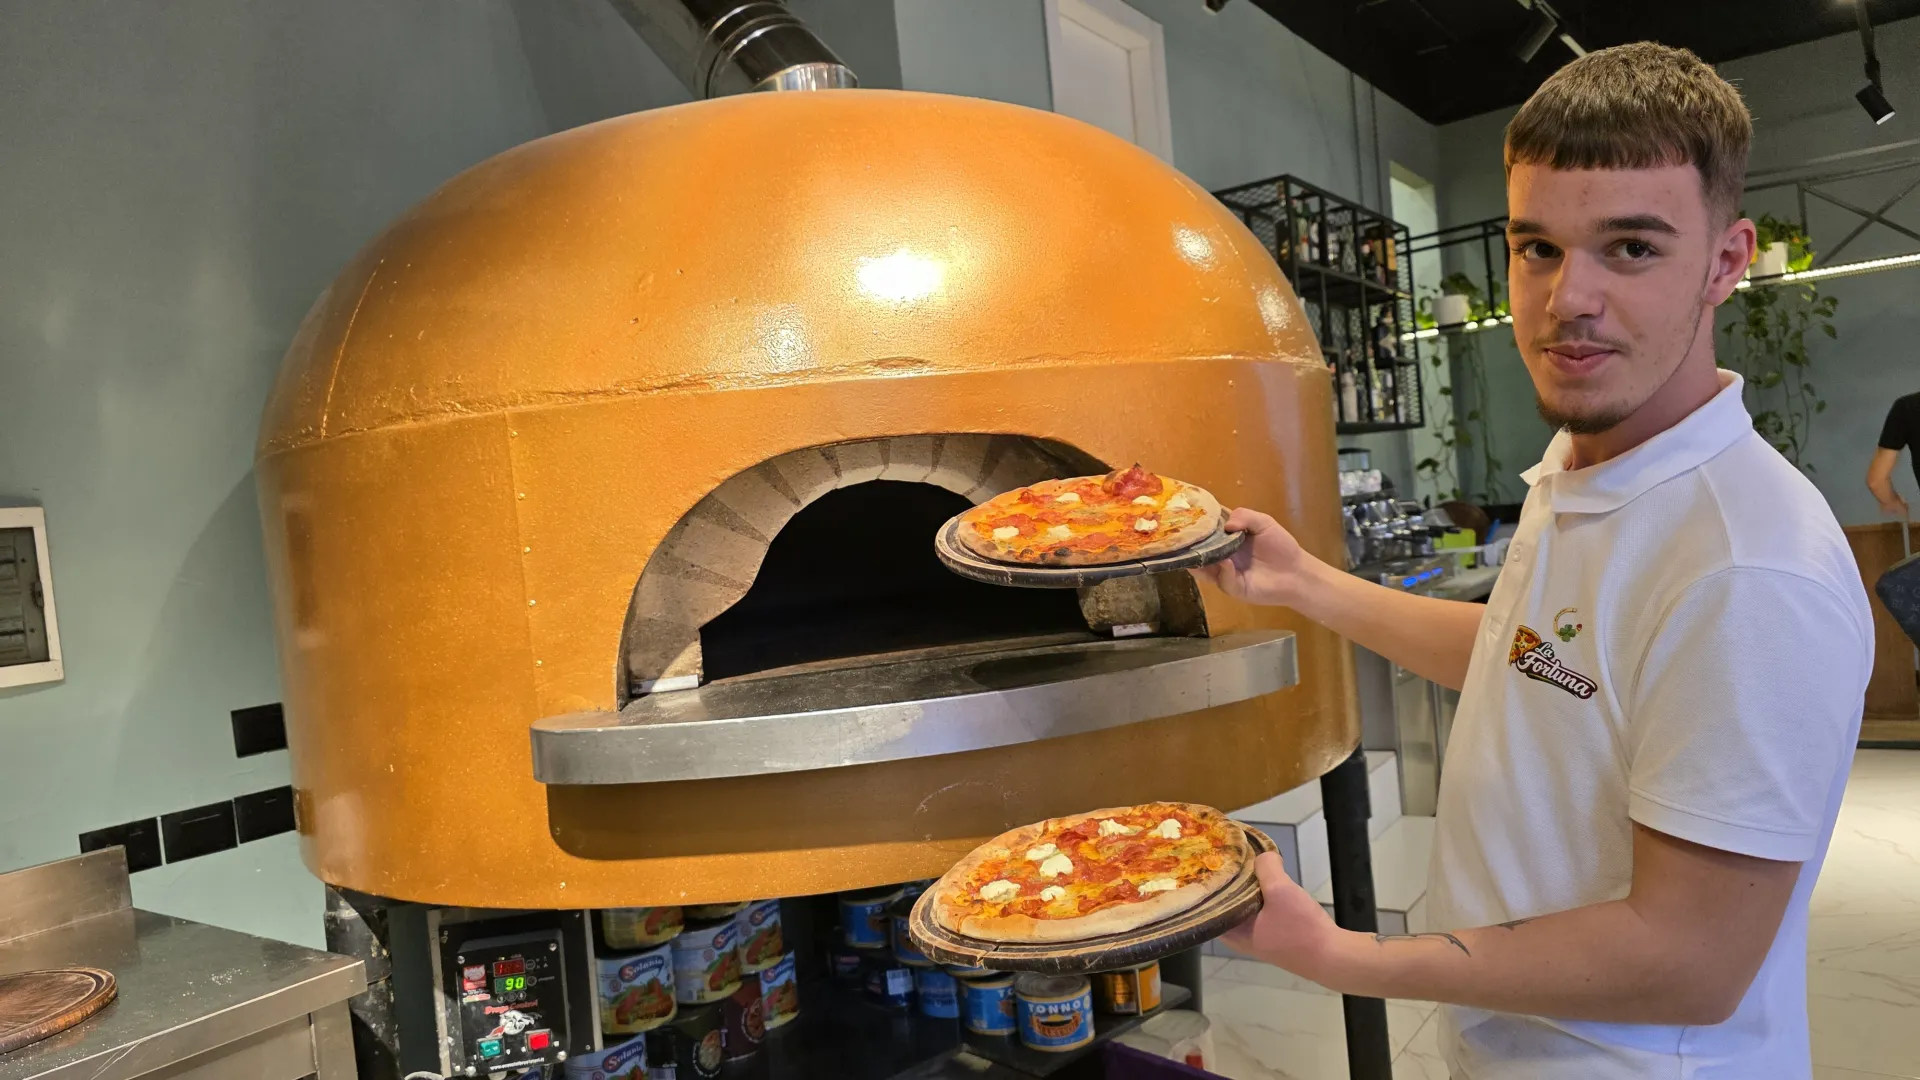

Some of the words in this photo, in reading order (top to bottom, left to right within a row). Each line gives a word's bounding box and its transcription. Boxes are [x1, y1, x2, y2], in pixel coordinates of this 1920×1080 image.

[1535, 642, 1553, 658] La
[1516, 650, 1597, 697] Fortuna
[505, 976, 525, 991] 90
[1028, 999, 1081, 1014] TONNO
[607, 1045, 643, 1070] Solania
